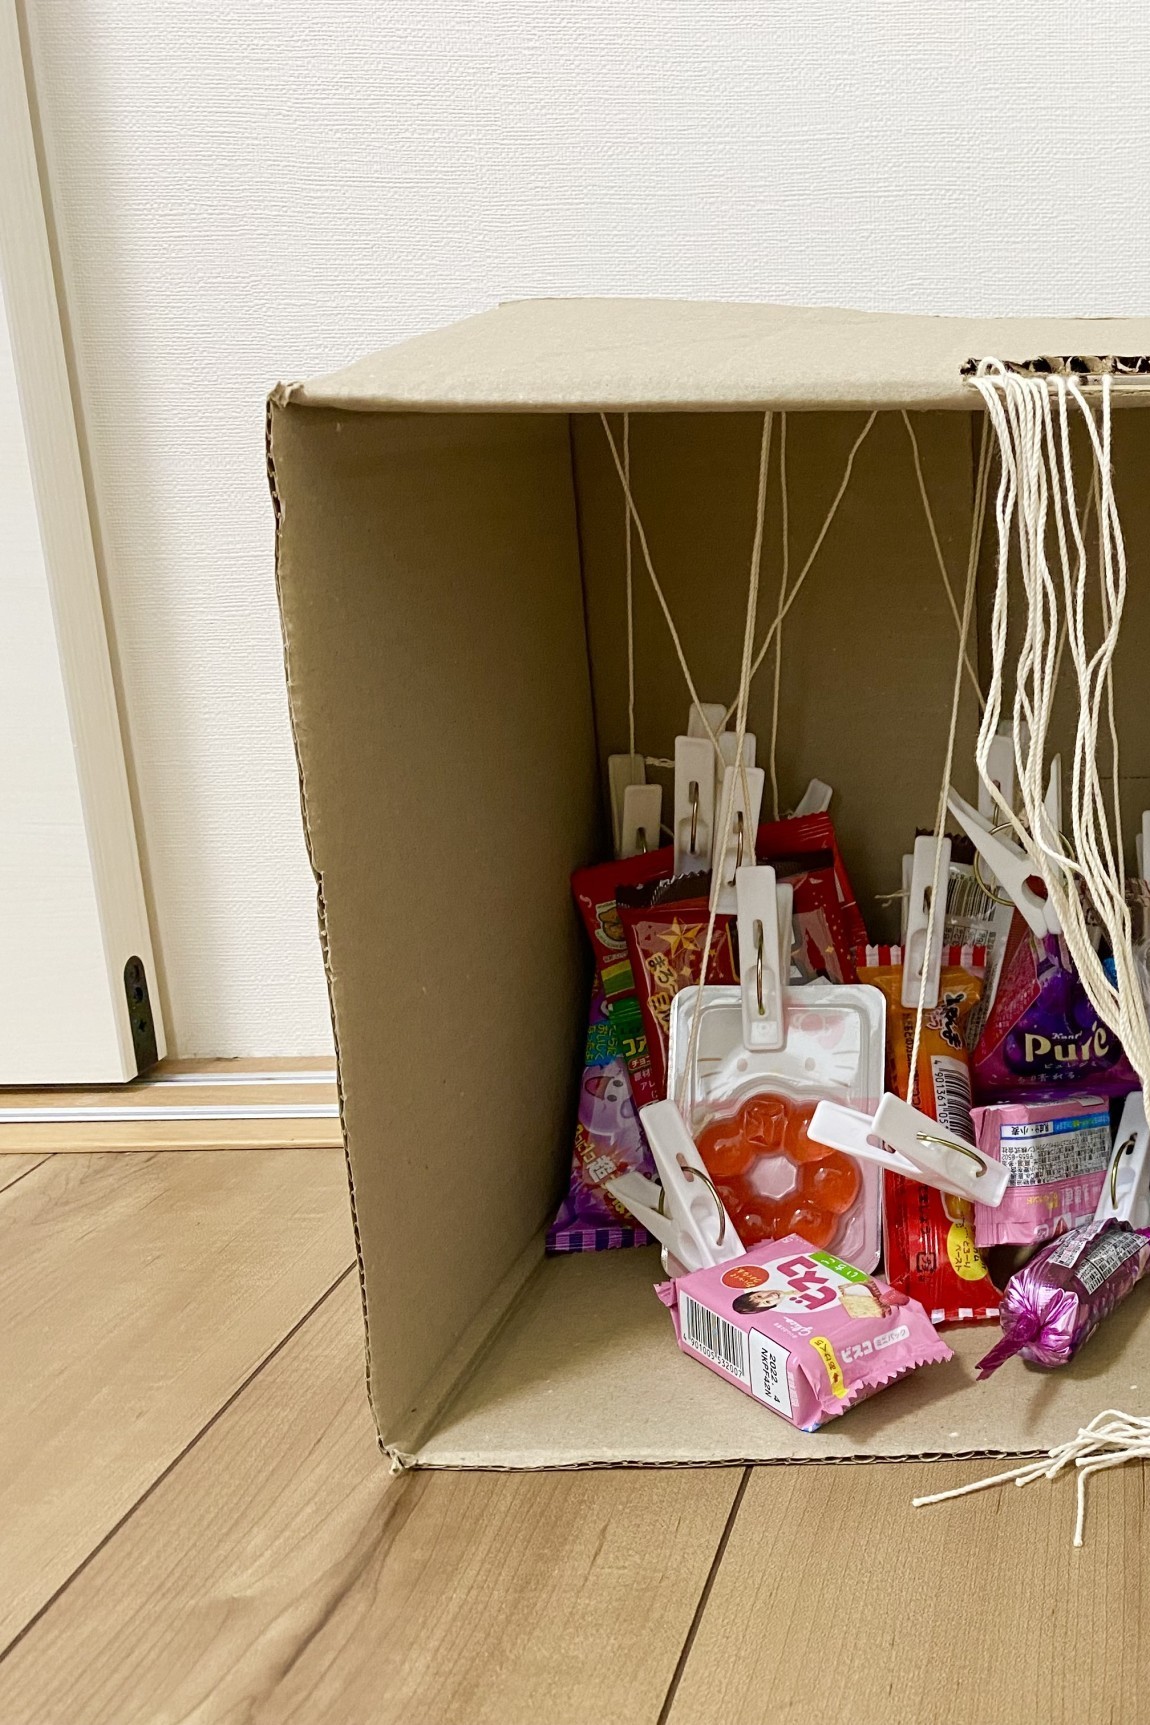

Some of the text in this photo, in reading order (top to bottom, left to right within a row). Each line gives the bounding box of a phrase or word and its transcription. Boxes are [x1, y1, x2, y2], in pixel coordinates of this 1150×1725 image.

[776, 1255, 838, 1311] ビスコ
[820, 1257, 860, 1278] いちご
[690, 1337, 715, 1361] 901005
[716, 1356, 743, 1378] 532007
[841, 1340, 873, 1363] ビスコ
